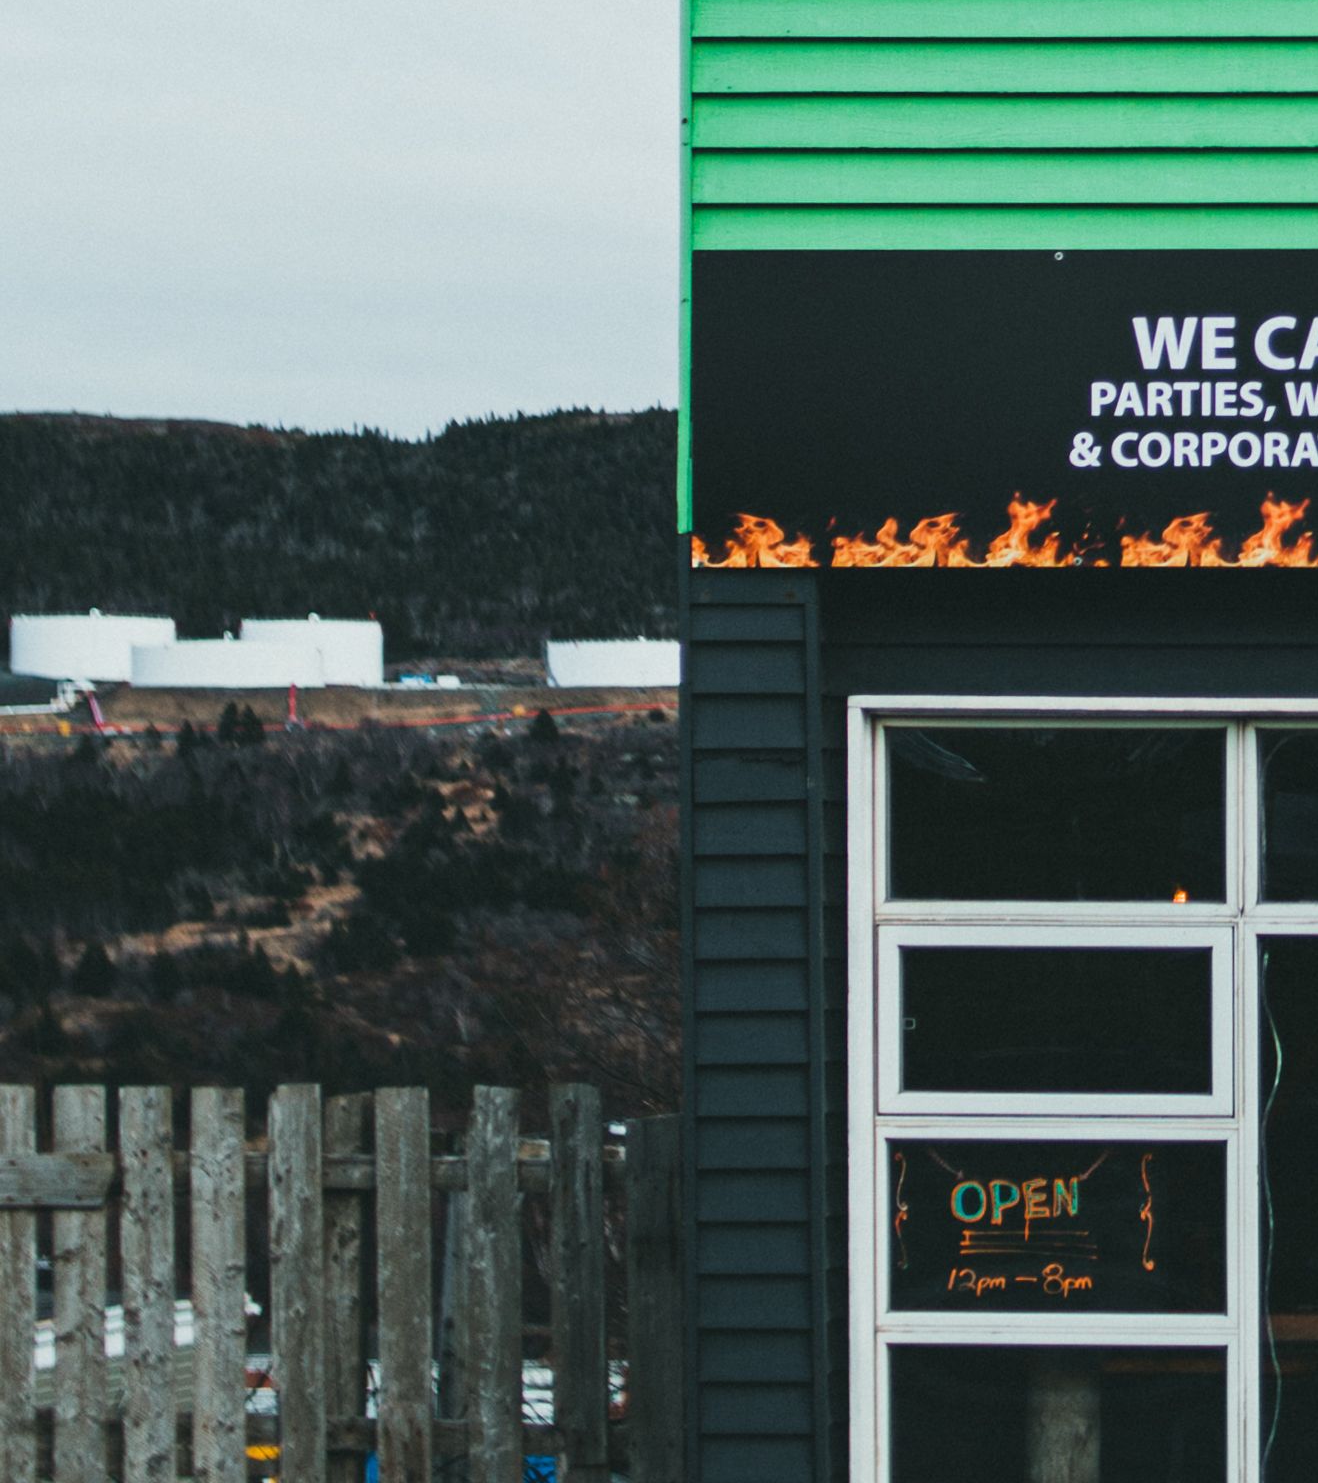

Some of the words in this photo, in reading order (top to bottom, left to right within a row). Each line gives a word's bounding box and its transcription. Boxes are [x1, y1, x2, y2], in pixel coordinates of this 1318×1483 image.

[1131, 316, 1237, 370] WE
[1090, 381, 1277, 422] PARTIES,
[1068, 431, 1102, 468] &
[951, 1177, 1079, 1226] OPEN
[948, 1268, 1006, 1297] 12pm
[1043, 1263, 1093, 1297] 8pm
